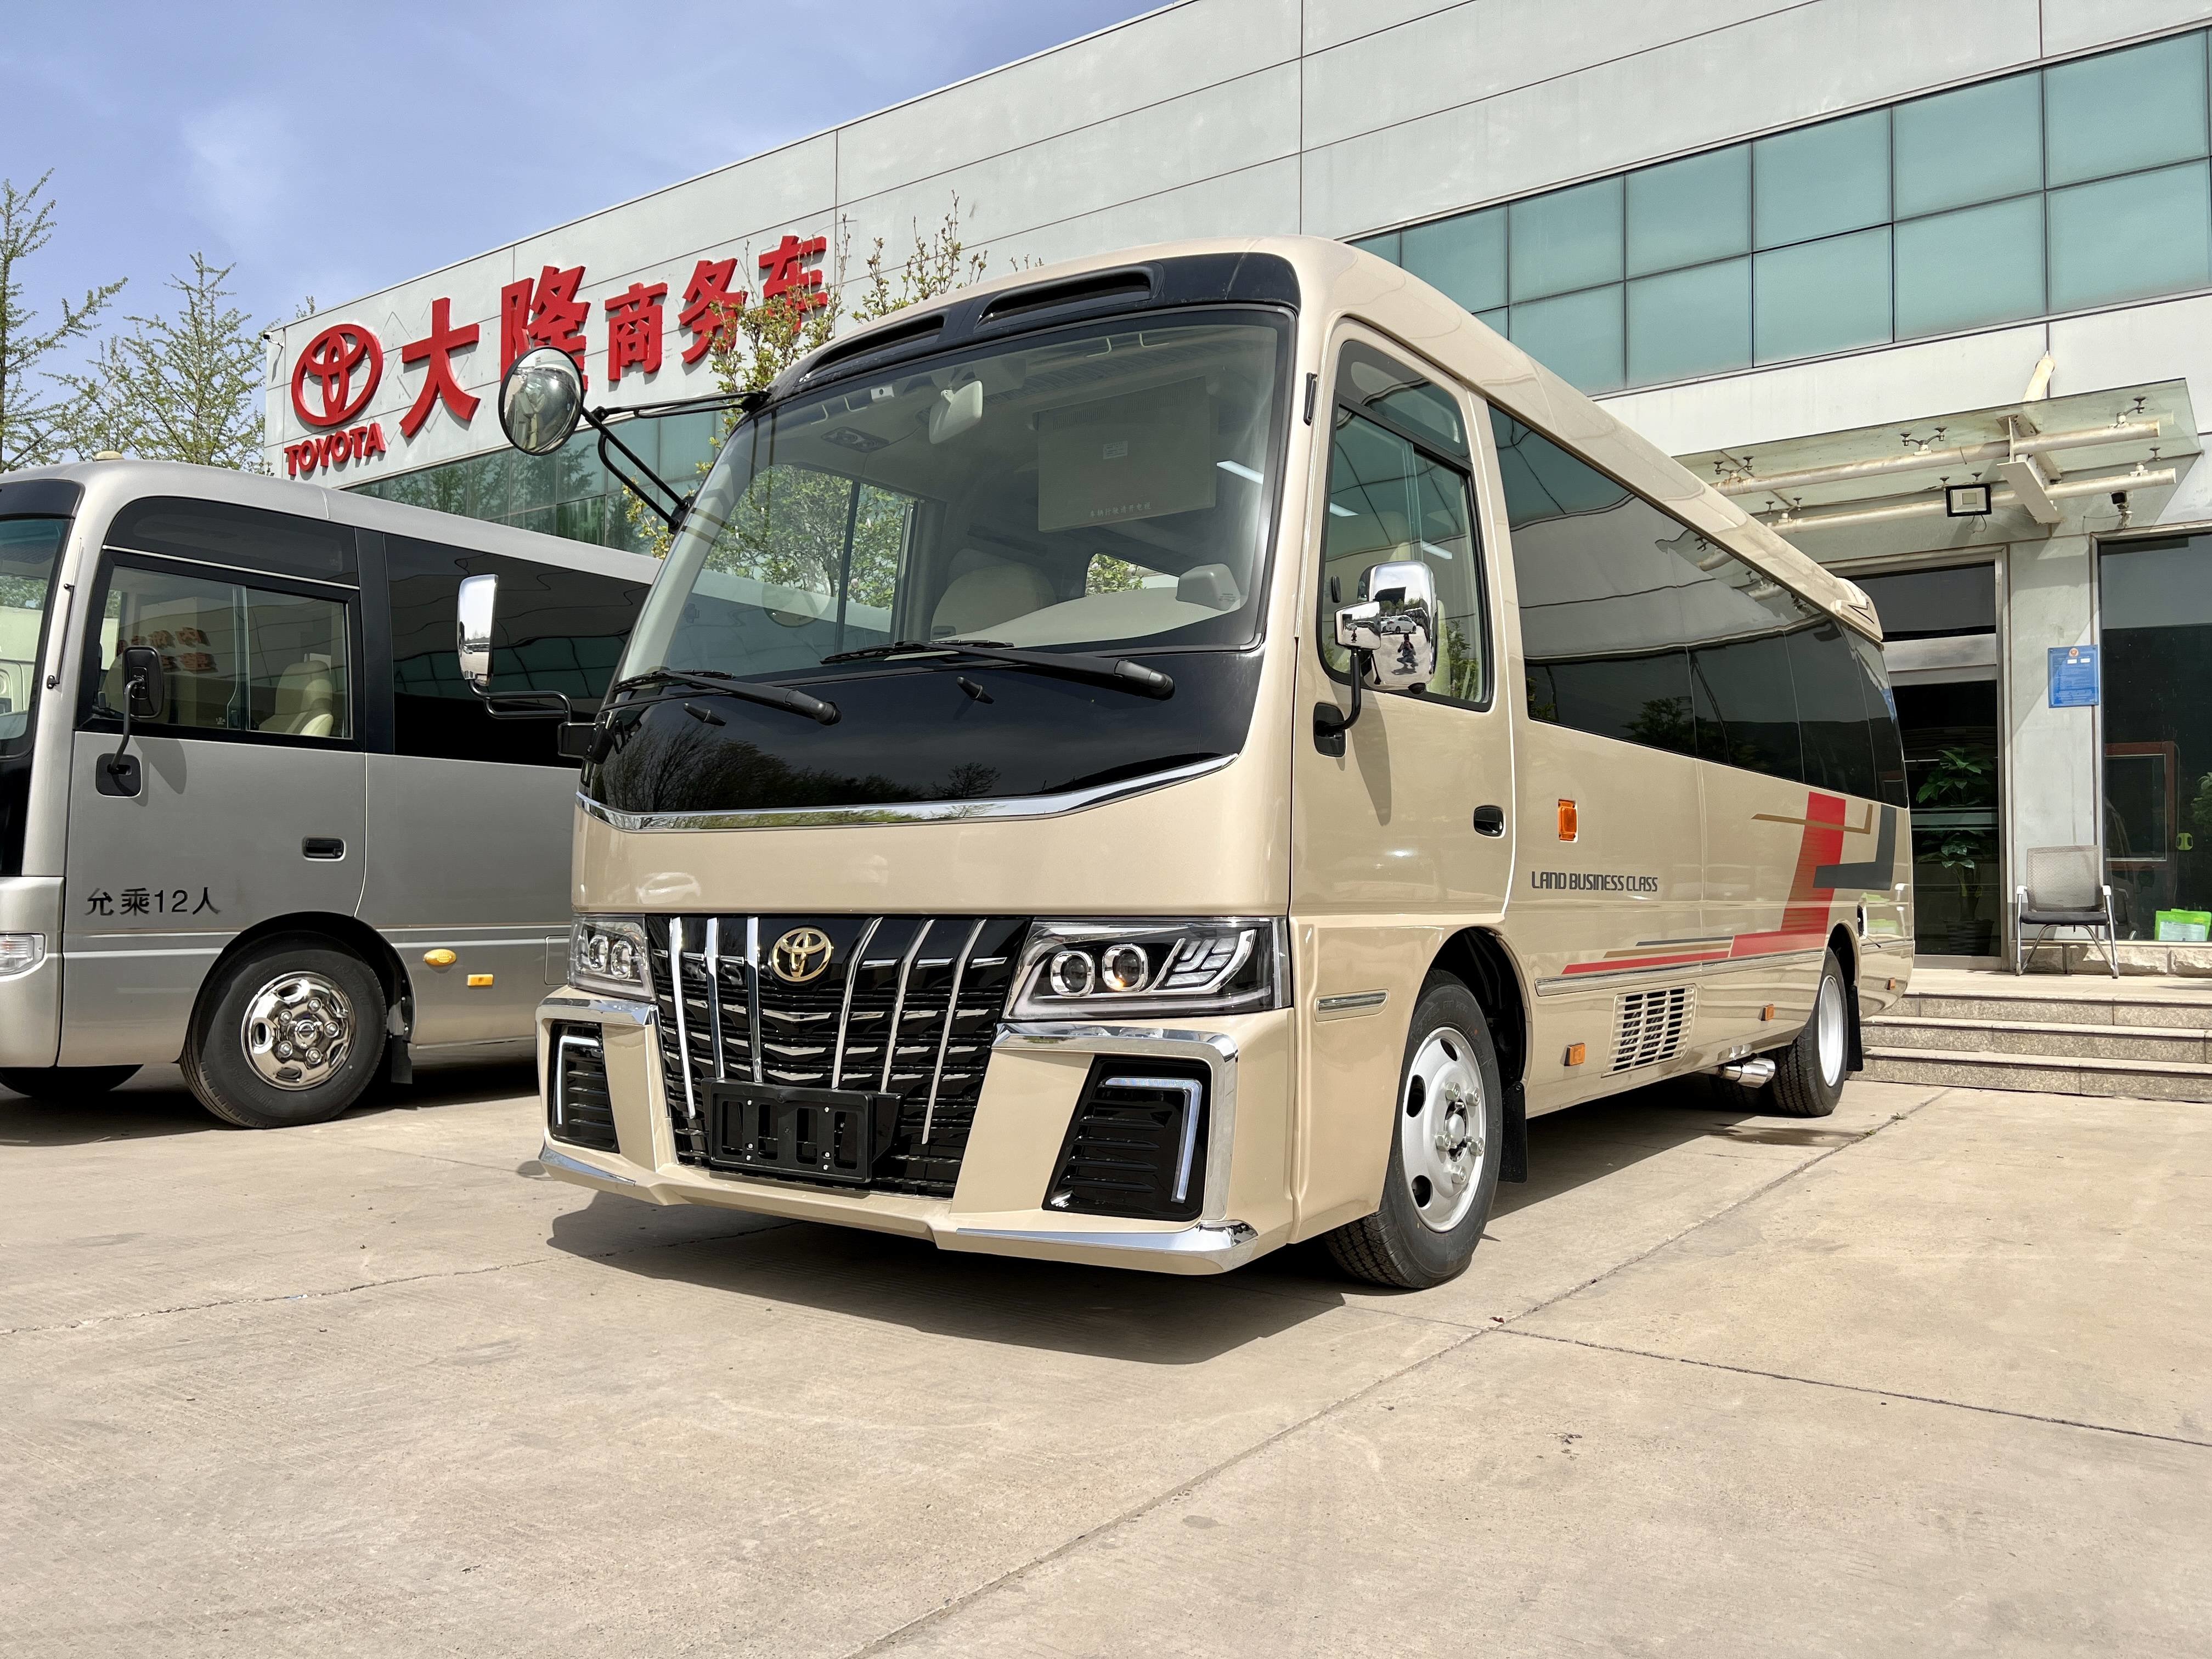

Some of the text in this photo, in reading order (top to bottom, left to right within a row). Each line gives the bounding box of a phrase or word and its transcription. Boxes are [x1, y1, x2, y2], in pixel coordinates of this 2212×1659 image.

[399, 235, 828, 438] 大隆商务车
[284, 422, 386, 476] TOYOTA
[83, 887, 221, 916] 允乘12人
[1531, 871, 1658, 892] LAND BUSINESS CLASS
